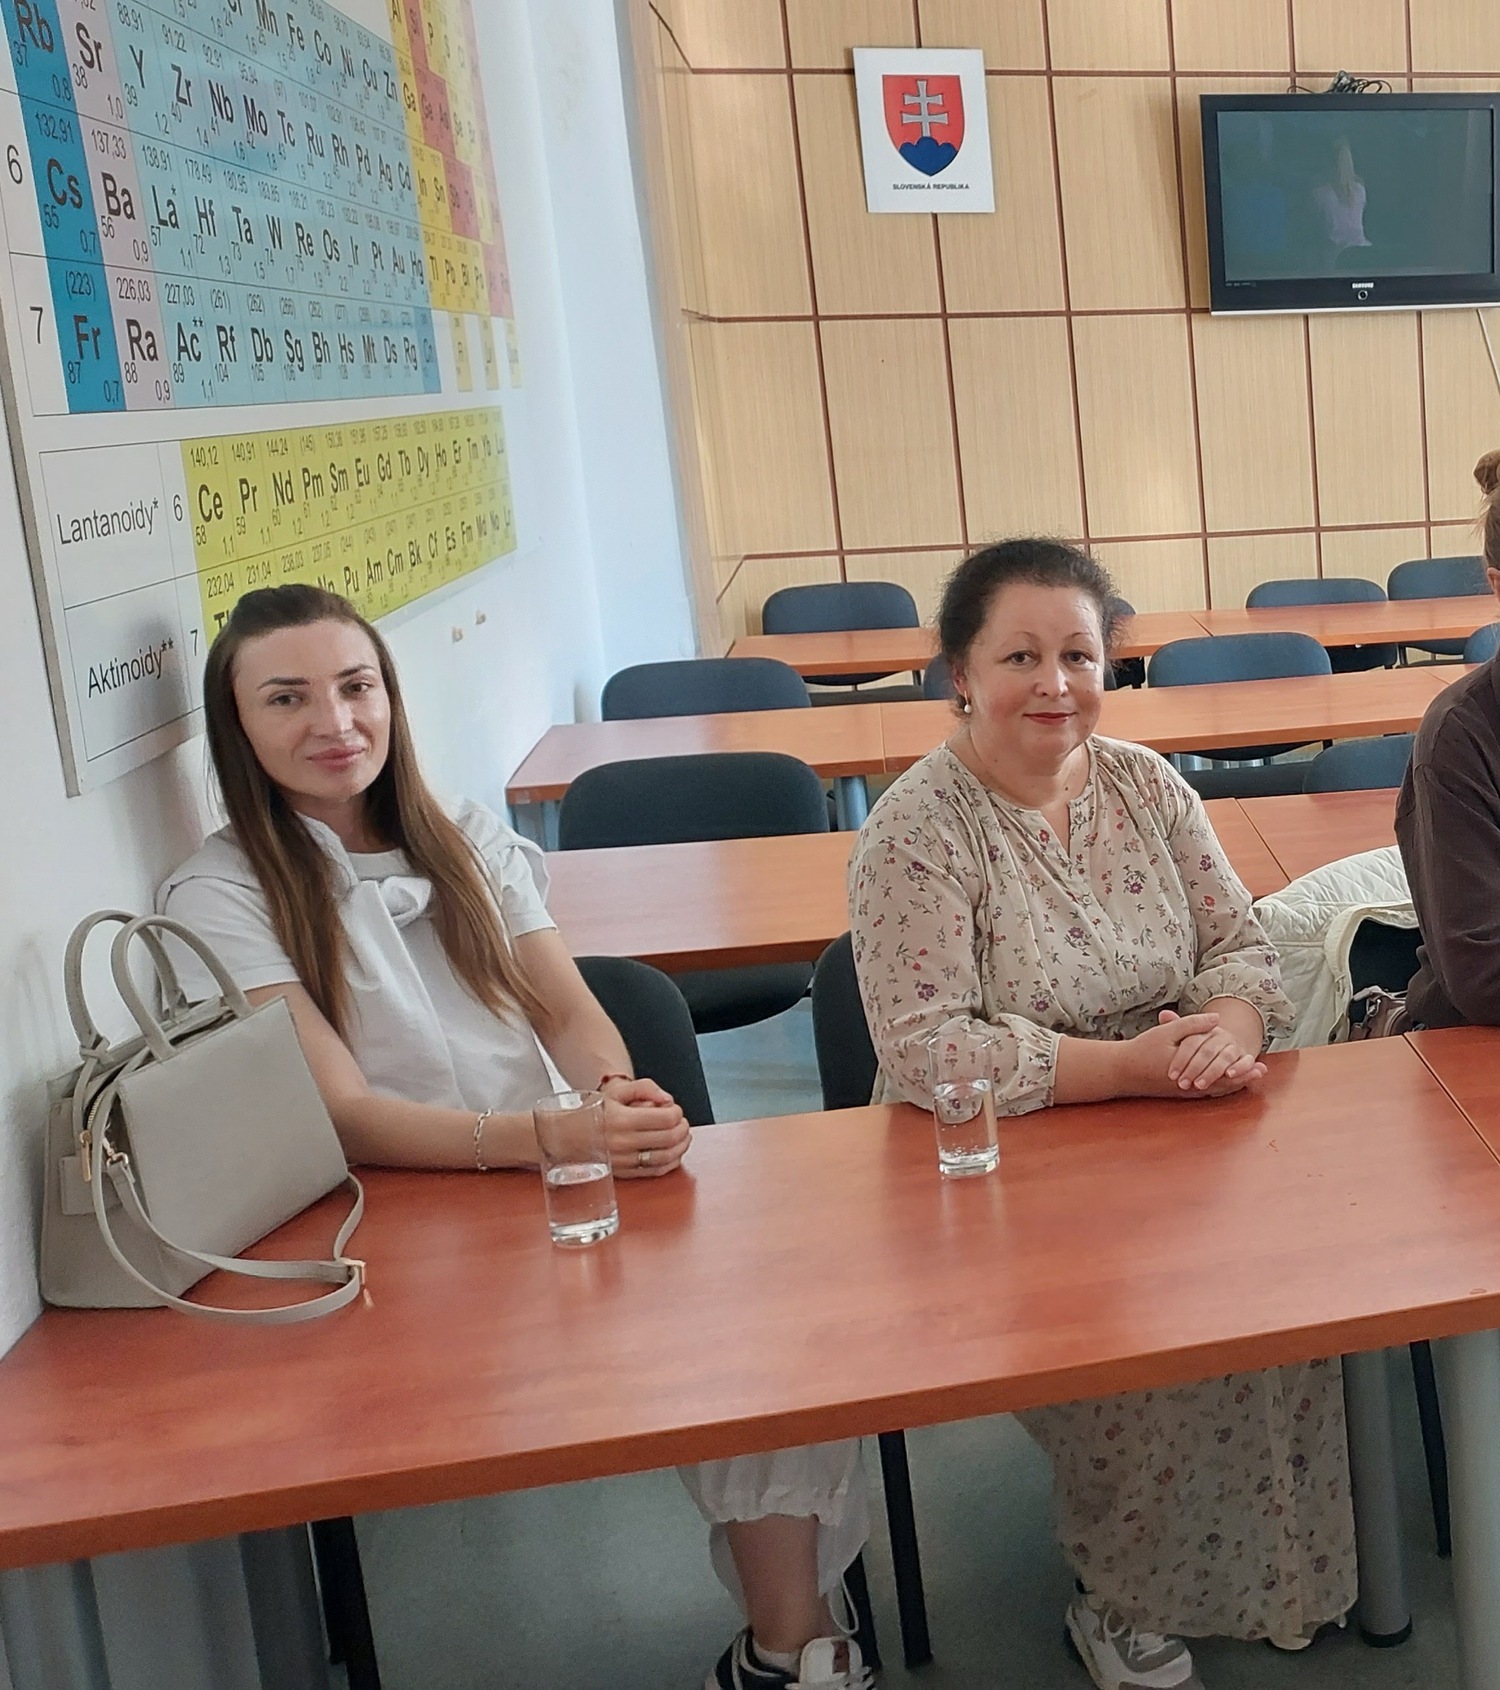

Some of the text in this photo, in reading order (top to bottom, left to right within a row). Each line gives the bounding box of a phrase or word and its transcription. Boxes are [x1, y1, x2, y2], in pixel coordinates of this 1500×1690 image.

[13, 40, 28, 68] 37
[72, 62, 89, 89] 38
[124, 82, 138, 107] 39
[286, 12, 305, 51] Fe
[314, 29, 332, 66] Co
[340, 44, 355, 79] Ni
[362, 58, 378, 92] Cu
[383, 70, 397, 102] Zn
[14, 0, 54, 53] Rb
[75, 21, 103, 73] Sr
[128, 44, 145, 89] Y
[170, 63, 192, 107] Zr
[208, 79, 234, 123] Nb
[243, 94, 268, 136] Mo
[277, 109, 295, 147] Tc
[305, 121, 325, 158] Ru
[331, 132, 349, 168] Rh
[355, 143, 371, 176] Pd
[378, 153, 393, 191] Ag
[398, 161, 411, 191] Cd
[35, 111, 75, 145] 132,91
[91, 128, 127, 160] 137,33
[141, 143, 173, 172] 138,91
[6, 144, 23, 184] 6
[47, 157, 83, 210] Cs
[101, 171, 136, 220] Ba
[194, 195, 217, 238] Hf
[231, 204, 255, 245] Ta
[265, 213, 283, 251] W
[295, 221, 315, 257] Re
[322, 228, 341, 263] Os
[349, 235, 360, 266] Ir
[371, 240, 385, 271] Pt
[391, 245, 406, 275] Au
[409, 250, 425, 285] Hg
[892, 182, 931, 190] SLOVENSKÁ
[43, 203, 60, 229] 55
[100, 215, 116, 239] 56
[150, 225, 162, 247] 57
[192, 233, 206, 255] 72
[230, 240, 242, 261] 73
[79, 229, 96, 257] 0,7
[132, 238, 150, 263] 0,9
[65, 269, 97, 302] (223)
[115, 275, 152, 303] 226,03
[164, 282, 196, 308] 227,03
[210, 288, 232, 316] (261)
[30, 305, 43, 345] 7
[73, 314, 101, 360] Fr
[125, 318, 159, 362] Ra
[216, 324, 237, 363] Rf
[250, 326, 274, 363] Db
[284, 328, 305, 373] Sg
[311, 330, 331, 364] Bh
[337, 332, 355, 364] Hs
[361, 333, 377, 364] Mt
[383, 335, 398, 364] Ds
[402, 336, 418, 371] Rg
[67, 360, 81, 385] 87
[123, 360, 138, 384] 88
[171, 361, 186, 384] 89
[103, 379, 120, 404] 0,7
[154, 378, 171, 403] 0,9
[172, 493, 184, 522] 6
[198, 483, 224, 523] Ce
[238, 477, 258, 515] Pr
[272, 468, 295, 508] Nd
[301, 466, 325, 501] Pm
[328, 461, 350, 494] Sm
[354, 457, 371, 488] Eu
[376, 451, 393, 482] Gd
[397, 448, 412, 477] Tb
[416, 446, 430, 479] Dy
[434, 442, 448, 468] Ho
[190, 444, 219, 469] 140,12
[231, 440, 256, 463] 140,91
[194, 524, 208, 547] 58
[235, 515, 247, 536] 59
[189, 628, 199, 657] 7
[343, 565, 360, 597] Pu
[366, 557, 384, 587] Am
[386, 548, 404, 576] Cm
[408, 539, 422, 568] Bk
[428, 530, 438, 559] Cf
[445, 526, 457, 552] Es
[206, 572, 235, 599] 232,04
[246, 560, 272, 585] 231,04
